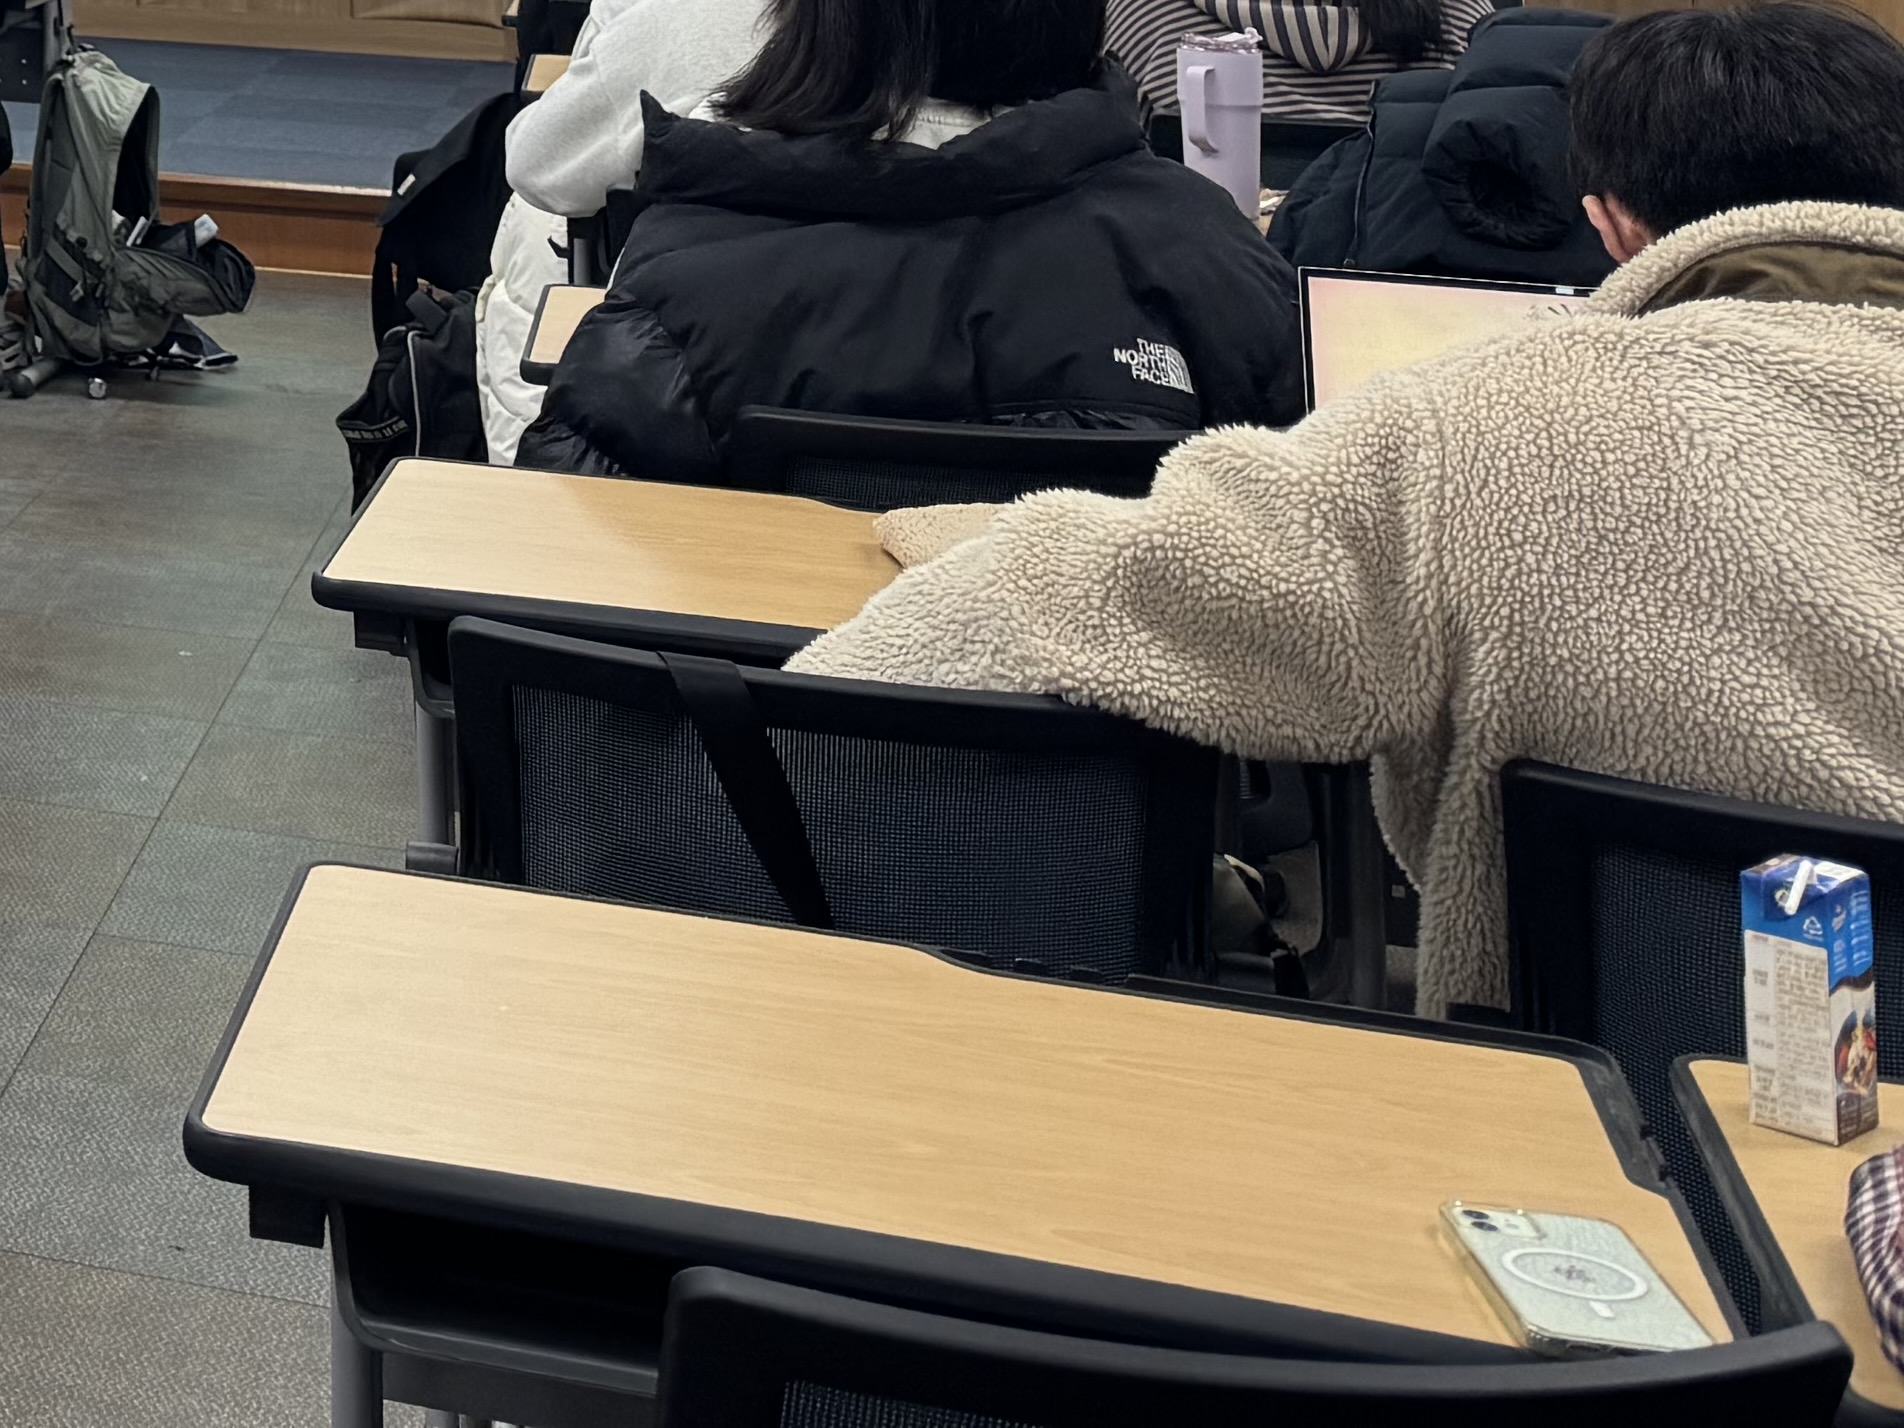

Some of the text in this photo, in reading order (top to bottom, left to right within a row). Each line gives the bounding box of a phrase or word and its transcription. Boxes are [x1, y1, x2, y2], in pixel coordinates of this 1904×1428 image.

[1136, 337, 1166, 358] THE
[1113, 348, 1167, 372] NORTH
[1131, 365, 1171, 386] FACE
